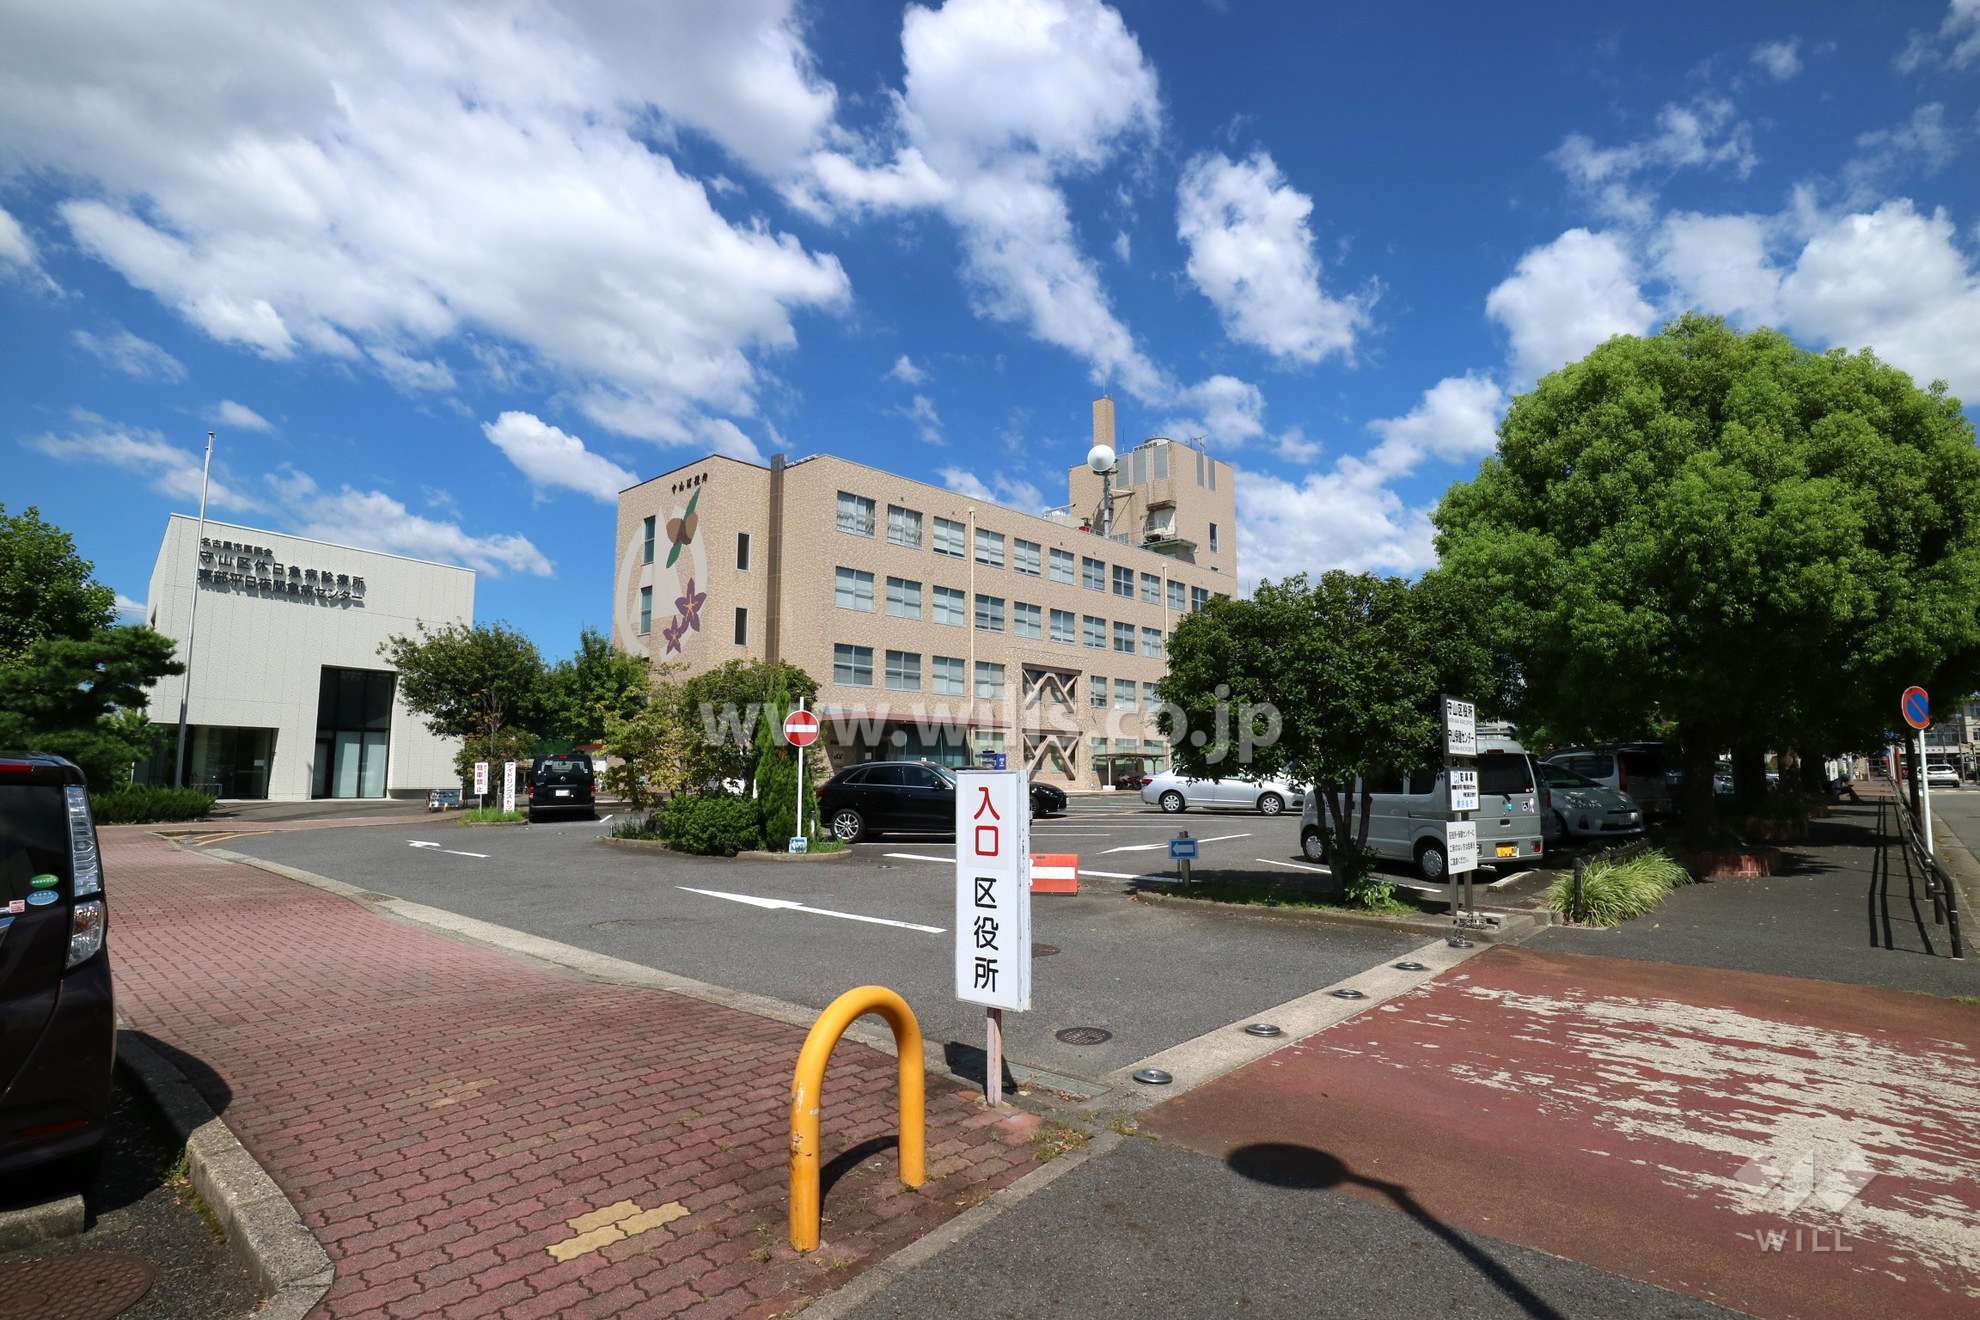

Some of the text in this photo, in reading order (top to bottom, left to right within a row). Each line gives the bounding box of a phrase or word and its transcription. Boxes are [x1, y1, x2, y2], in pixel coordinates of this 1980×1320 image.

[199, 551, 366, 588] 守山区休日急病診療所
[973, 786, 1001, 857] 入口
[973, 877, 1000, 993] 区役所
